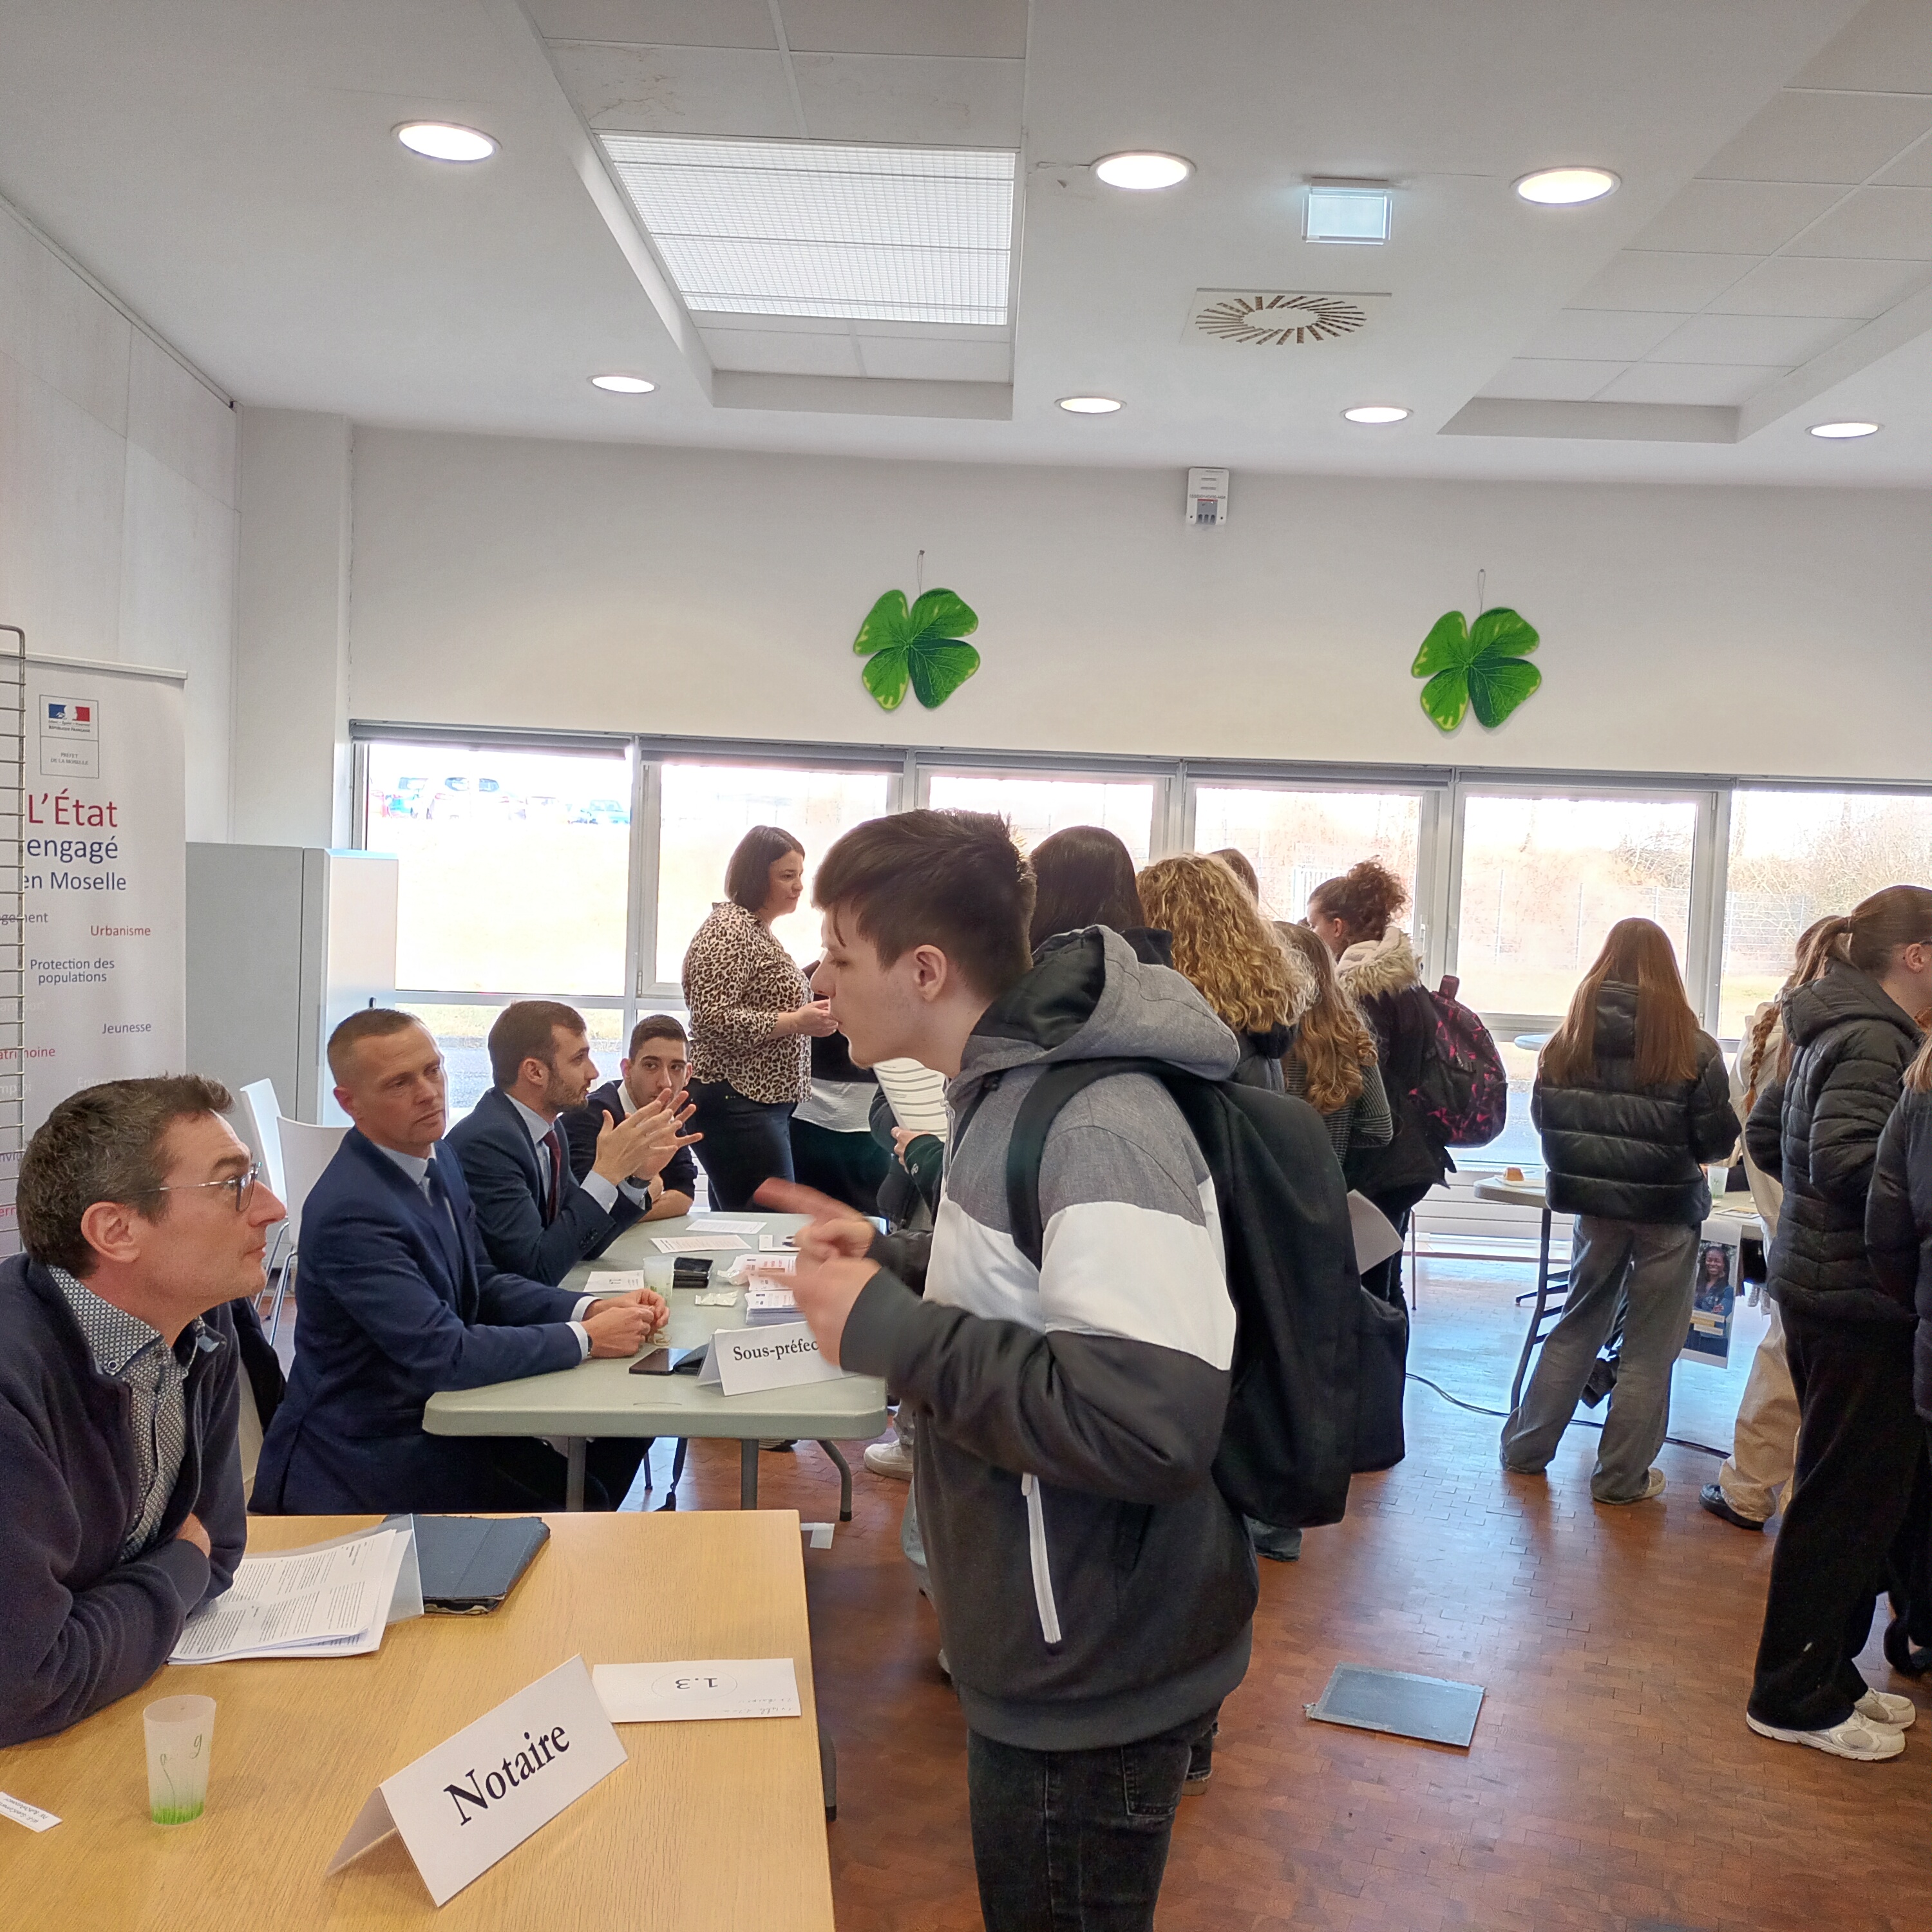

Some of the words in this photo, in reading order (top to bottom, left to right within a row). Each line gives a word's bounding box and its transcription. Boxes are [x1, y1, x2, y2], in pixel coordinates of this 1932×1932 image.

[28, 788, 118, 828] L'État
[27, 835, 118, 864] engagé
[51, 871, 126, 890] Moselle
[91, 925, 151, 936] Urbanisme
[30, 958, 90, 970] Protection
[94, 958, 115, 969] des
[38, 971, 107, 985] populations
[102, 1023, 151, 1034] Jeunesse
[675, 1678, 719, 1690] 1.3
[443, 1727, 570, 1826] Notaire
